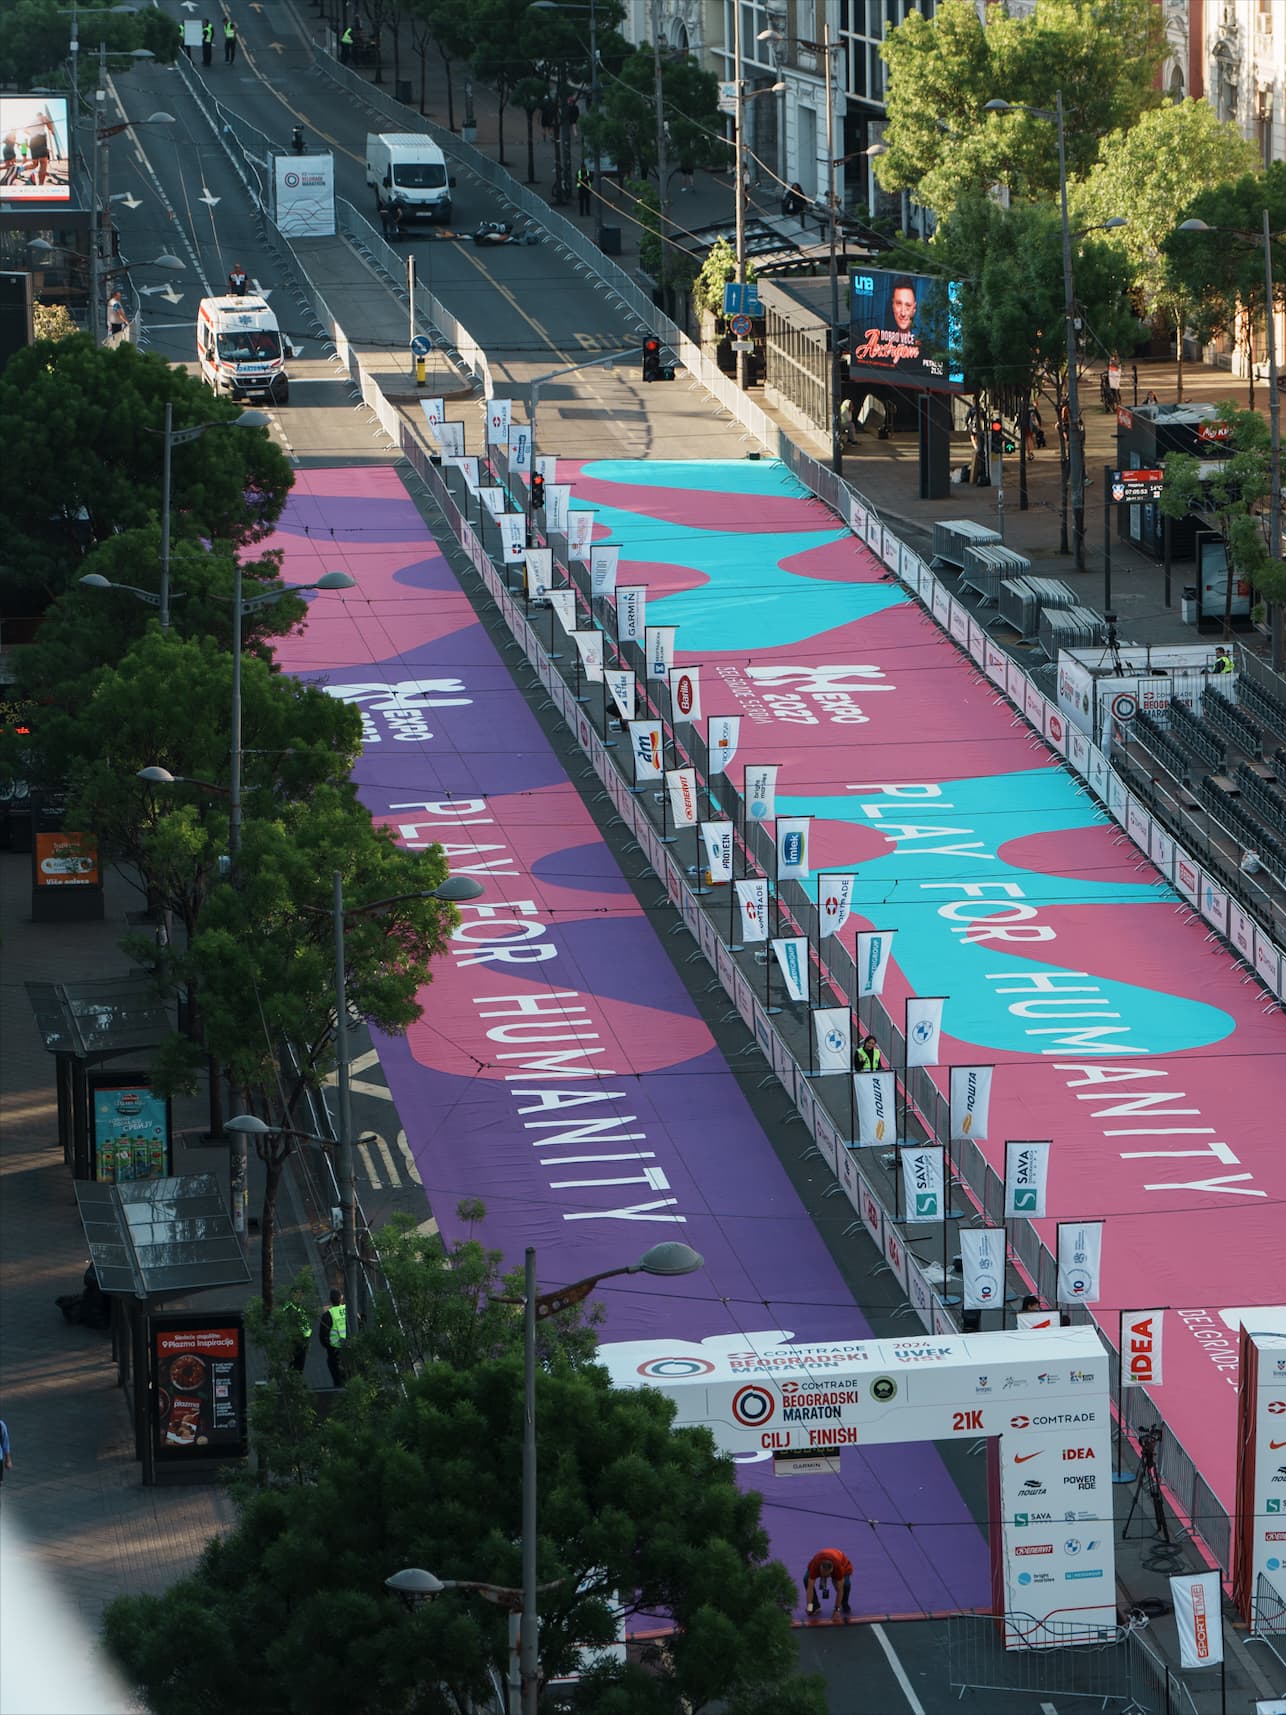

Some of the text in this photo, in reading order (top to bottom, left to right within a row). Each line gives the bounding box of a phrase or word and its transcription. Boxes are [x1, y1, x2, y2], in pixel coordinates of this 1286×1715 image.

[680, 679, 689, 710] Barilla
[762, 693, 820, 725] 2027
[811, 693, 870, 724] EXPO
[383, 710, 434, 742] EXPO
[638, 736, 652, 763] dm
[722, 833, 731, 869] PROTEIN
[786, 833, 799, 866] imlek
[846, 782, 1267, 1198] PLAY FOR HUMANITY
[390, 799, 687, 1222] PLAY FOR HUMANITY
[917, 1154, 928, 1189] SAVA
[1017, 1149, 1029, 1184] SAVA
[981, 1286, 992, 1300] 10
[1073, 1280, 1084, 1294] 10
[893, 1342, 931, 1350] 2024
[1177, 1309, 1239, 1372] BELGRADE
[729, 1352, 869, 1368] BEOGRADSKI
[763, 1346, 866, 1358] COMTRADE
[894, 1347, 953, 1358] UVEK
[731, 1361, 841, 1374] MARATON
[801, 1379, 858, 1391] COMTRADE
[783, 1391, 859, 1408] BEOGRADSKI
[783, 1405, 842, 1422] MARATON
[952, 1410, 985, 1431] 21K
[1032, 1412, 1096, 1426] COMTRADE
[761, 1427, 858, 1449] CILJ FINISH
[1064, 1475, 1096, 1484] POWER
[1031, 1512, 1052, 1521] SAVA
[1190, 1584, 1209, 1658] SPORT TIME
